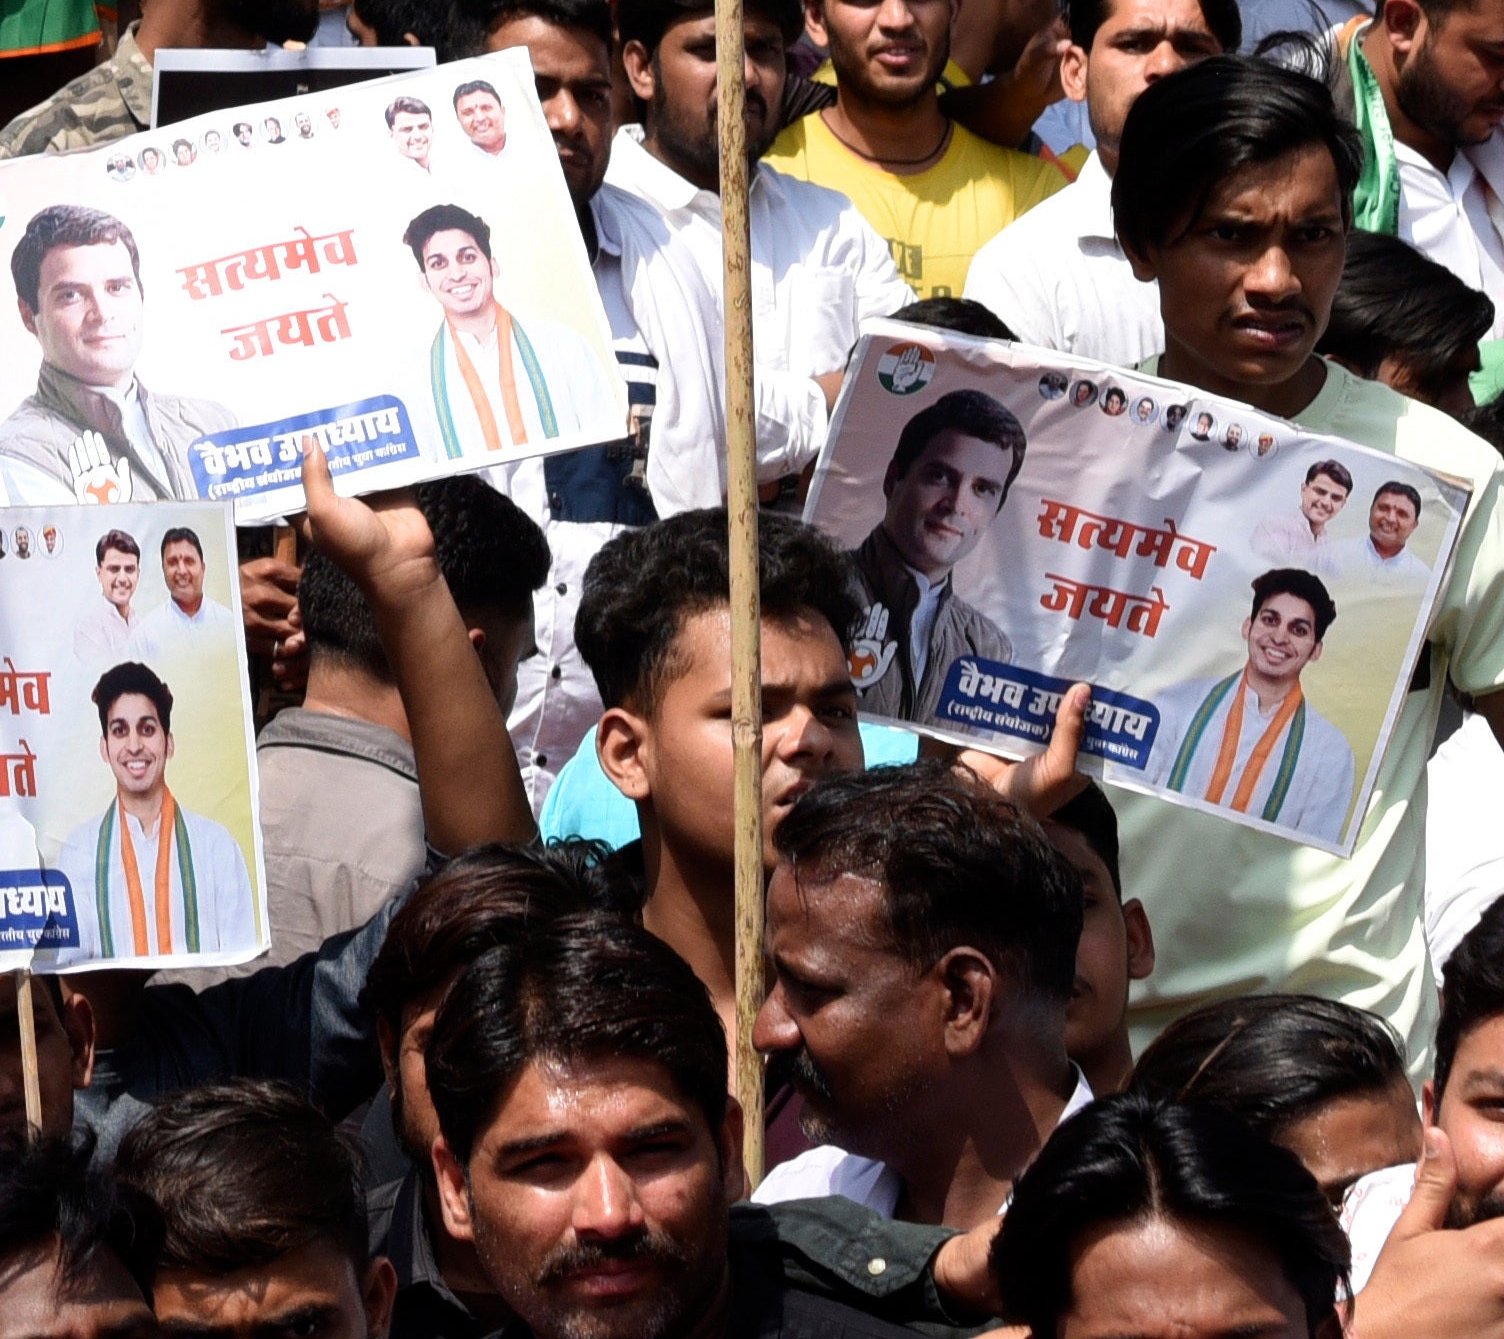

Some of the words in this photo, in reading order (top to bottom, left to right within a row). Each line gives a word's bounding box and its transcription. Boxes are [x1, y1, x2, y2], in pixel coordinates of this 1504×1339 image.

[175, 225, 359, 302] सत्यमेव
[221, 292, 354, 362] जयते
[194, 436, 273, 476] वैभव
[1037, 498, 1218, 581] सत्यमेव
[1038, 572, 1171, 639] जयते
[958, 659, 1029, 708] वैभव
